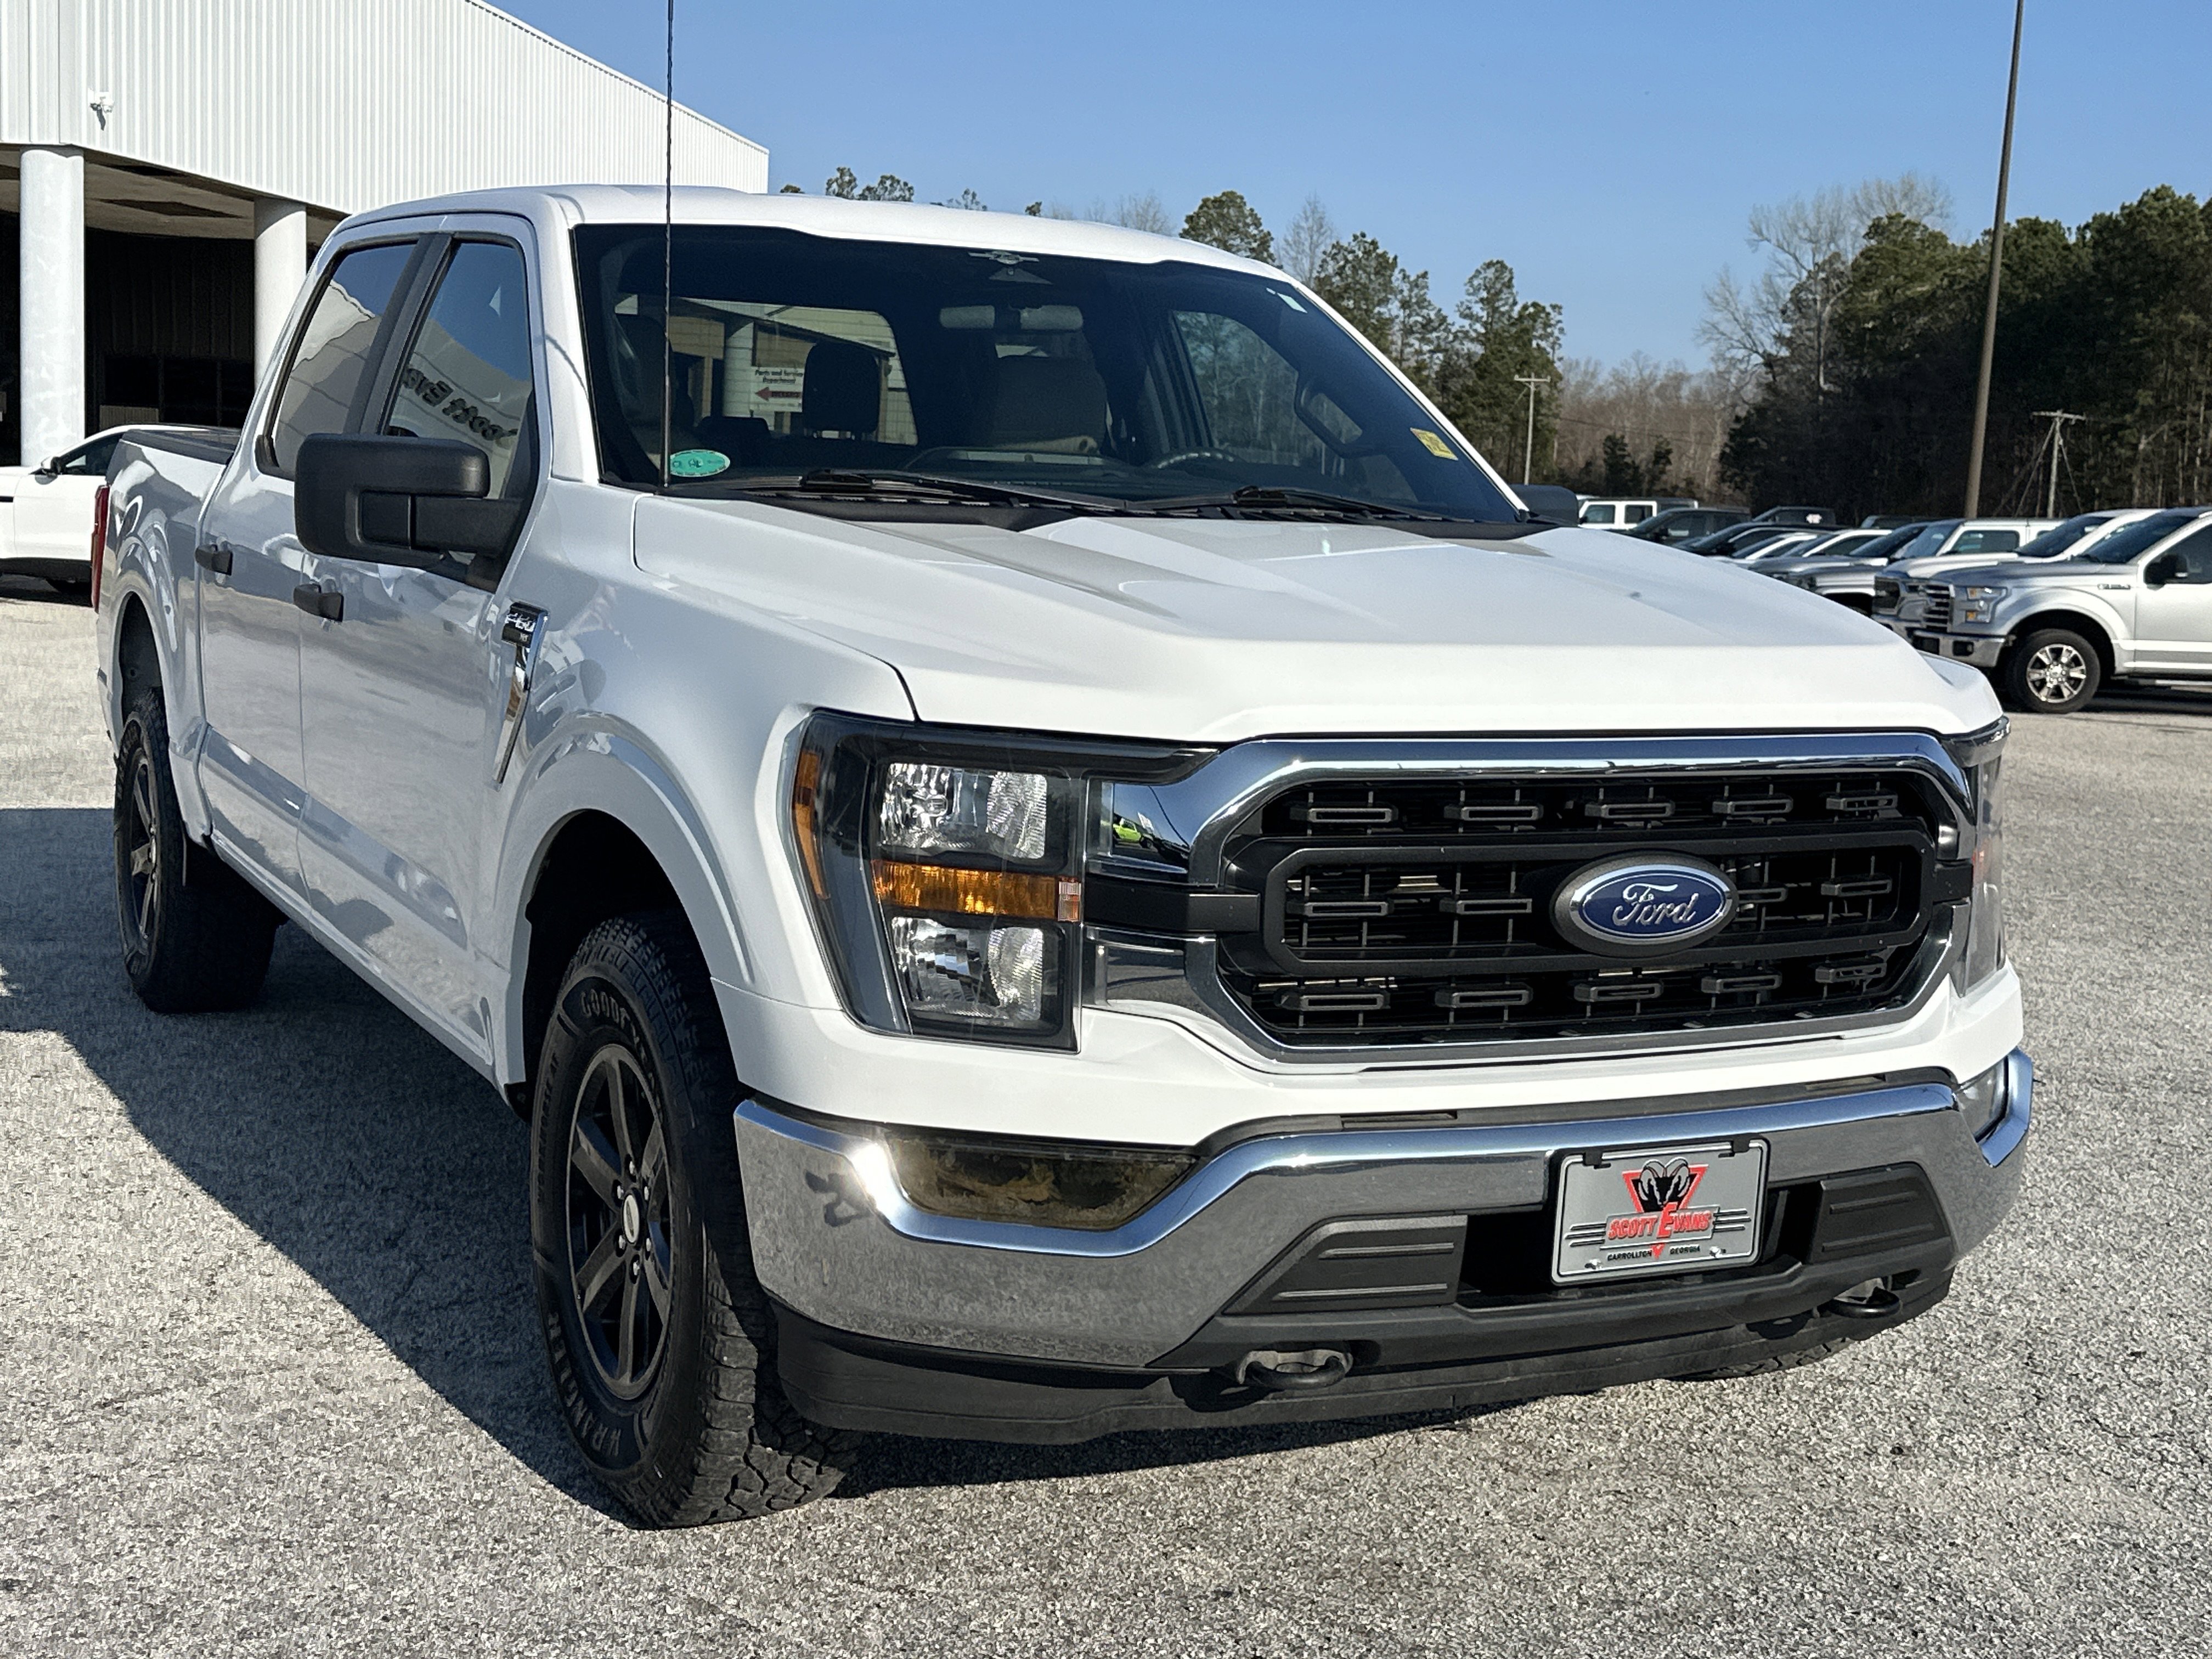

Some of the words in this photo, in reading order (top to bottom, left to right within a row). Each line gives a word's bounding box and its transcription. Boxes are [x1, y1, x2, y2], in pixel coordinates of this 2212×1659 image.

[1613, 883, 1699, 926] Ford
[1608, 1216, 1657, 1240] SCOTT
[1656, 1202, 1711, 1238] EVANS
[1607, 1250, 1652, 1261] CARROLLTON
[1669, 1245, 1701, 1255] GEORGIA
